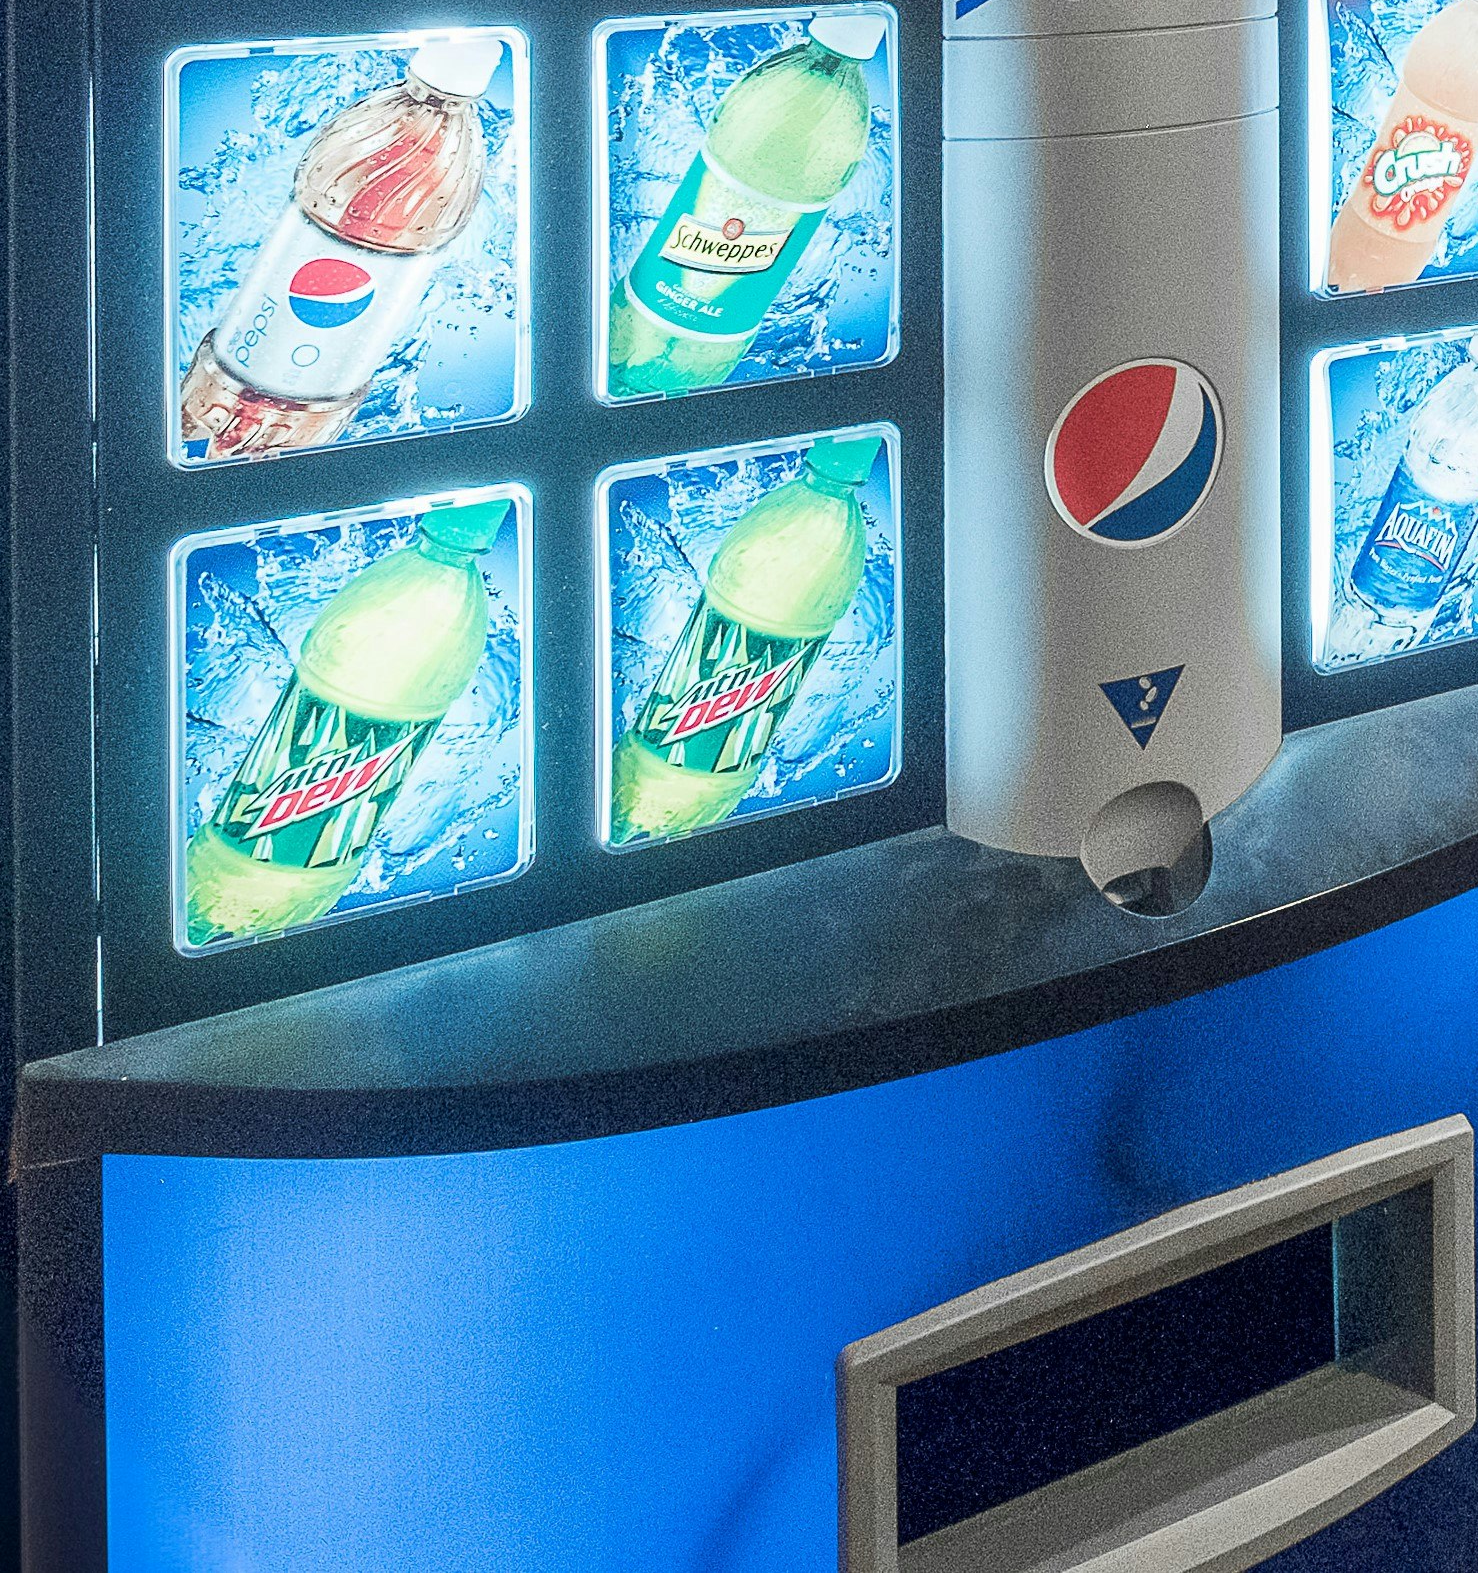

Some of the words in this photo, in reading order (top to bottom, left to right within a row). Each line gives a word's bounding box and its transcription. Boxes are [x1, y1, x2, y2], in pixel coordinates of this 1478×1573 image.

[670, 224, 778, 263] Schweppes
[655, 280, 699, 312] GINGER
[698, 303, 724, 318] ALE
[235, 293, 279, 368] pepsi
[1375, 501, 1458, 570] AQUAFINA
